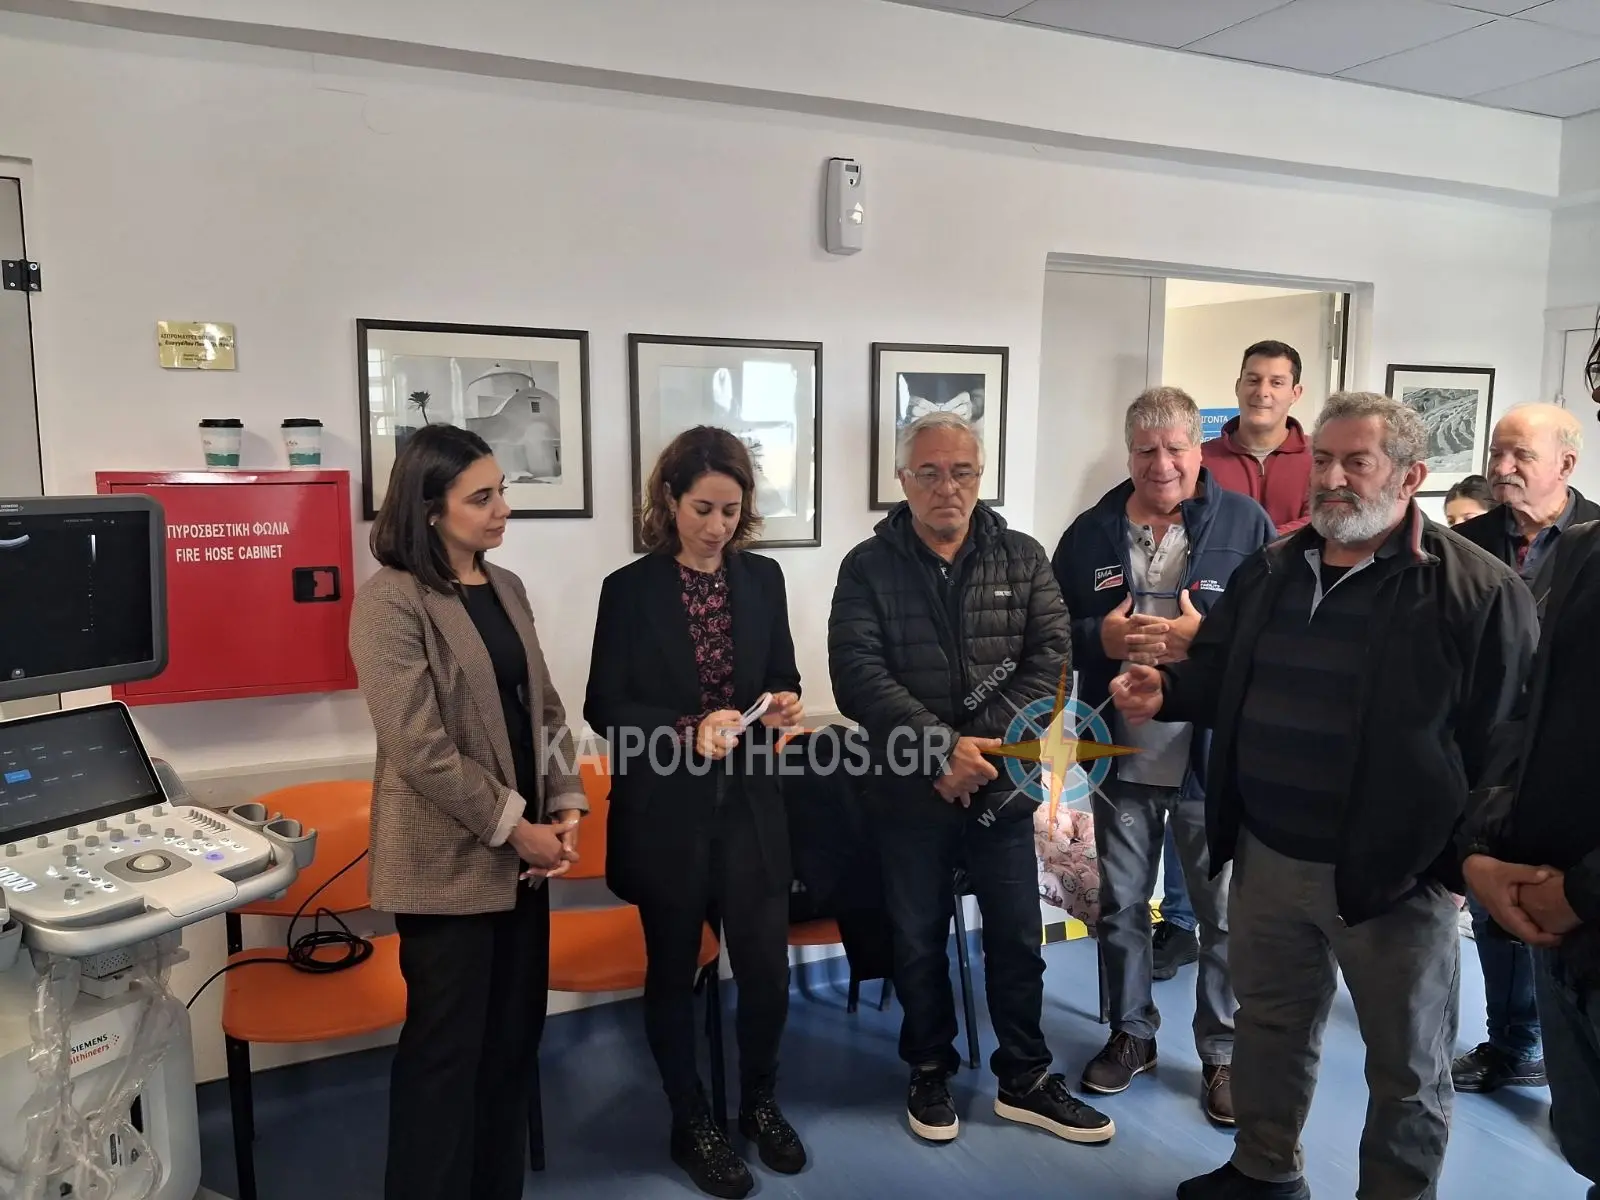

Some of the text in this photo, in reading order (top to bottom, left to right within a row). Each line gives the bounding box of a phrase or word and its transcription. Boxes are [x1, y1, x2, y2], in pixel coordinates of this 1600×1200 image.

[1201, 415, 1228, 424] ΙΓΟΝΤΑ
[167, 521, 290, 539] ΠΥΡΟΣΒΕΣΤΙΚΗ ΦΩΛΙΑ
[176, 544, 283, 562] FIRE HOSE CABINET
[1097, 569, 1113, 580] SMA
[71, 1033, 108, 1055] SIEMENS
[69, 1043, 110, 1065] althineers
